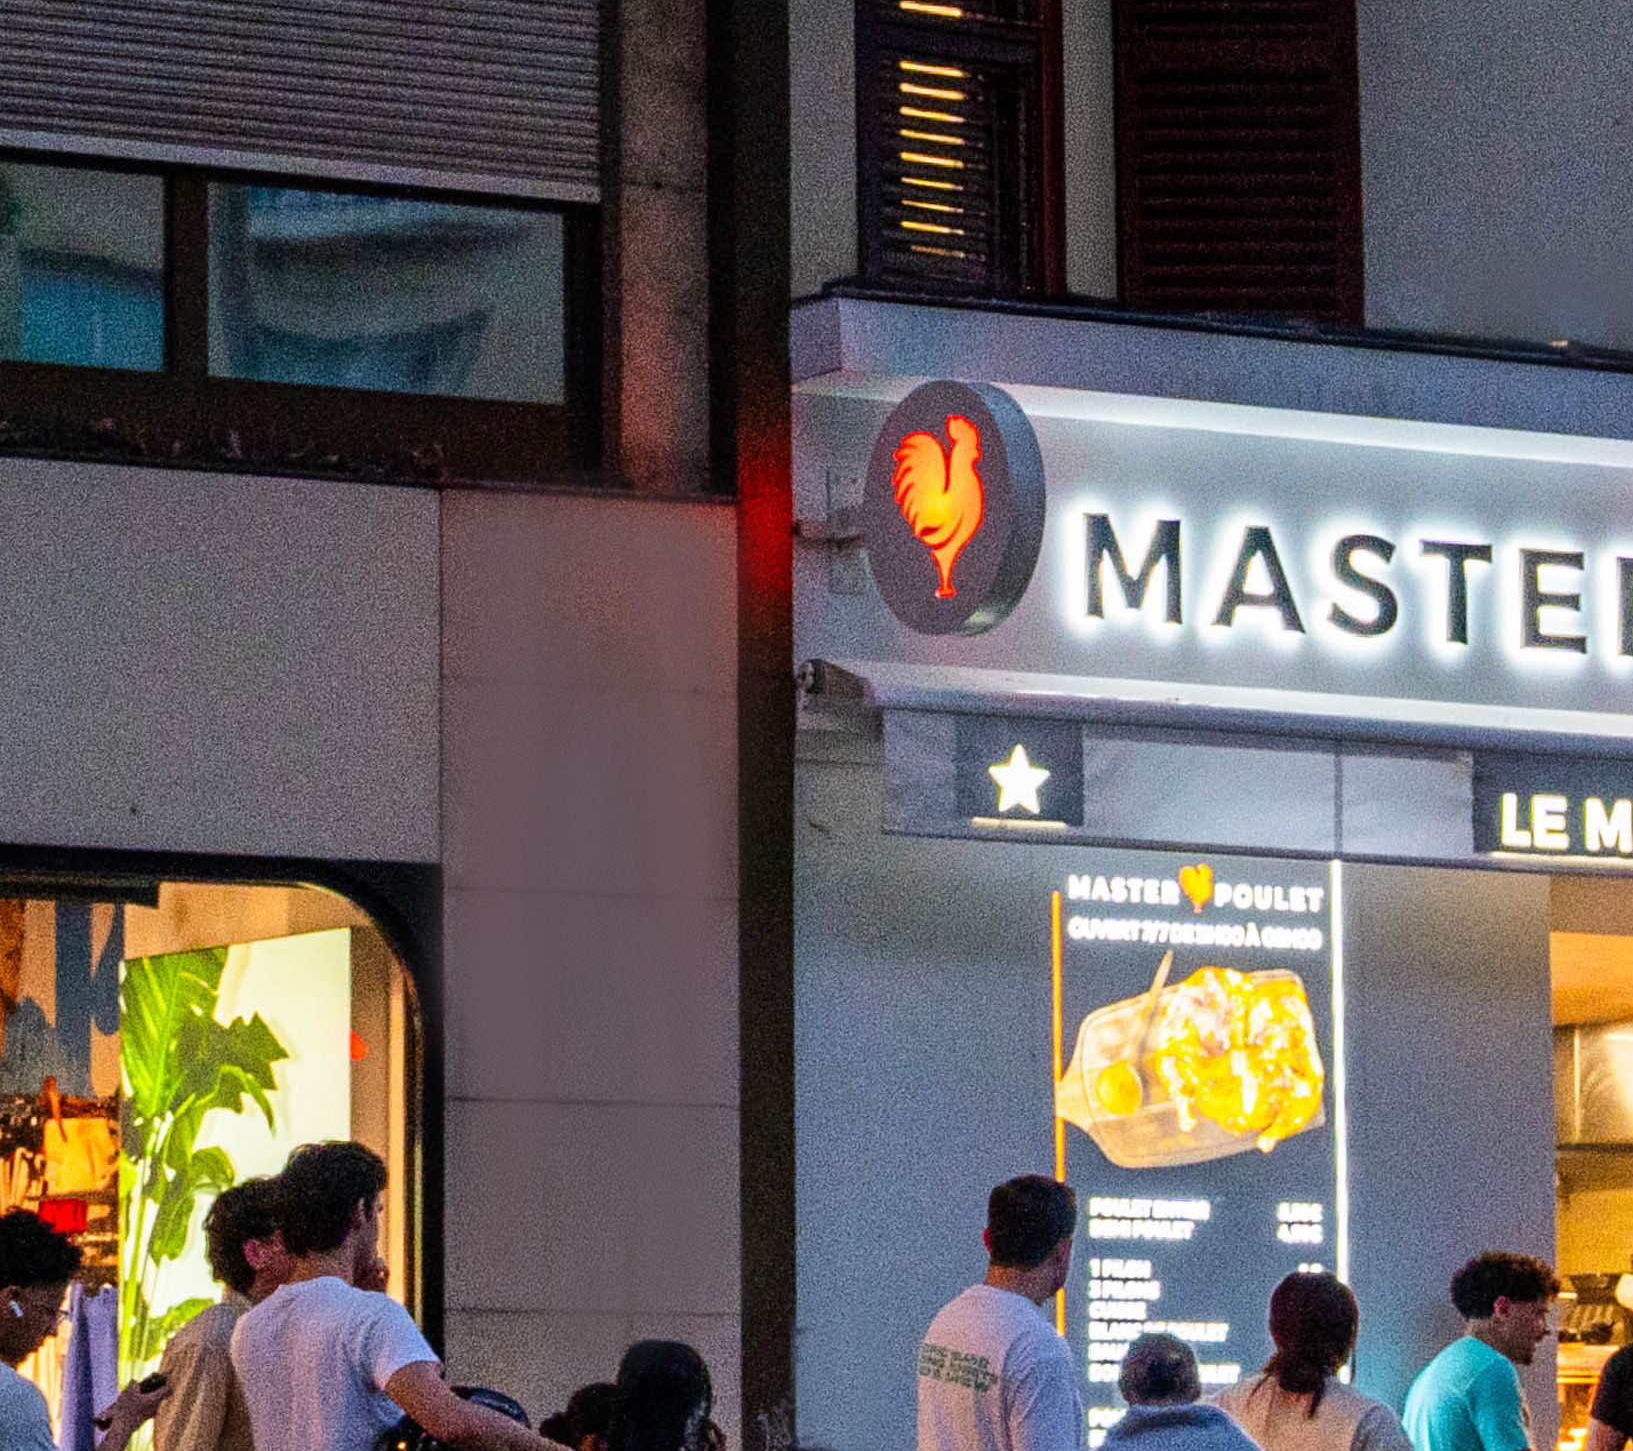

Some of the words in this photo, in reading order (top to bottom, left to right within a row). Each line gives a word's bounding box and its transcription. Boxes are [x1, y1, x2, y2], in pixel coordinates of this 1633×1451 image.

[1500, 793, 1569, 851] LE
[1067, 874, 1180, 905] MASTER
[1214, 882, 1324, 912] POULET
